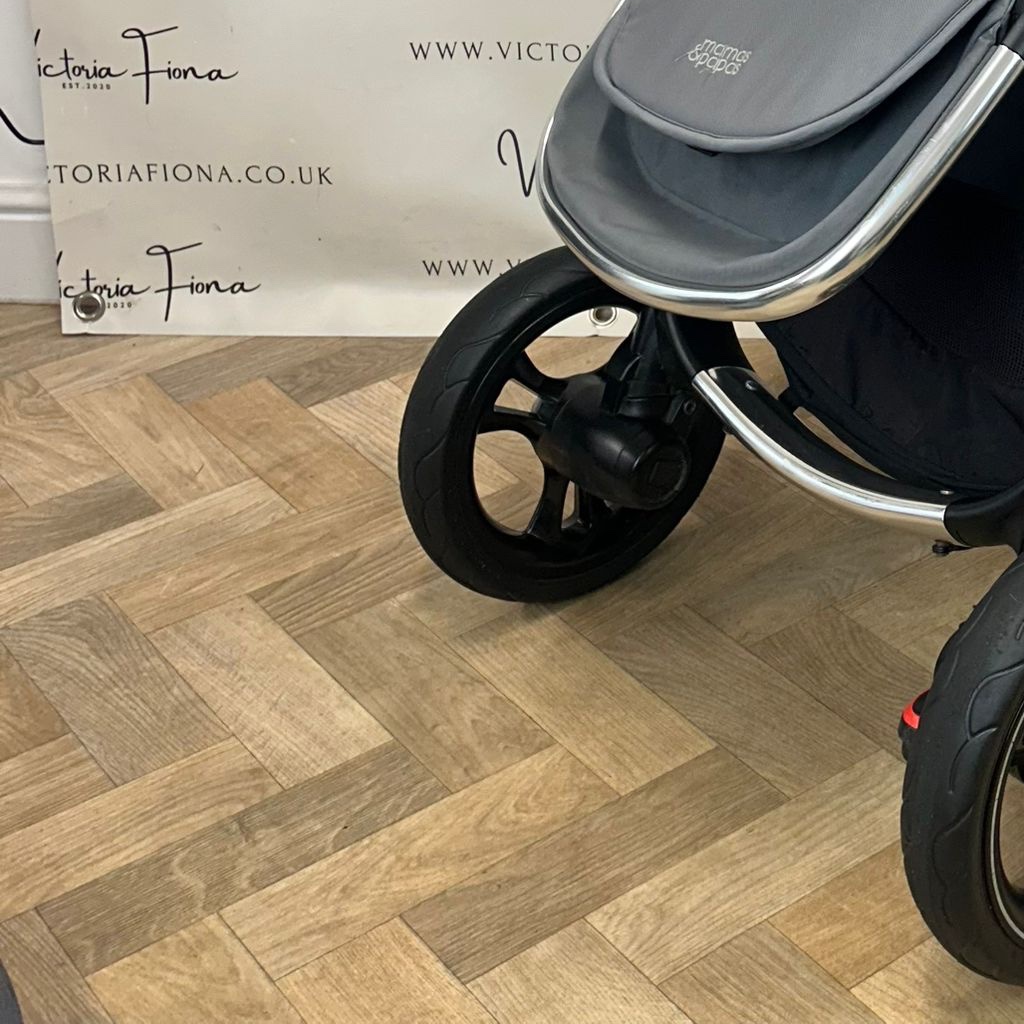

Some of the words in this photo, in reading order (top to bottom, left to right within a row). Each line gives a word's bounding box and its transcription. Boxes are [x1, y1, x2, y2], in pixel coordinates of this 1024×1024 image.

[410, 42, 590, 63] WWW.VICTO
[701, 39, 752, 63] mamas
[34, 29, 128, 80] ictoria
[121, 26, 238, 105] Fiona
[62, 82, 111, 90] EST.2020
[47, 164, 333, 185] TORIAFIONA.CO.UK
[57, 251, 150, 300] ictoria
[146, 243, 261, 322] Fiona
